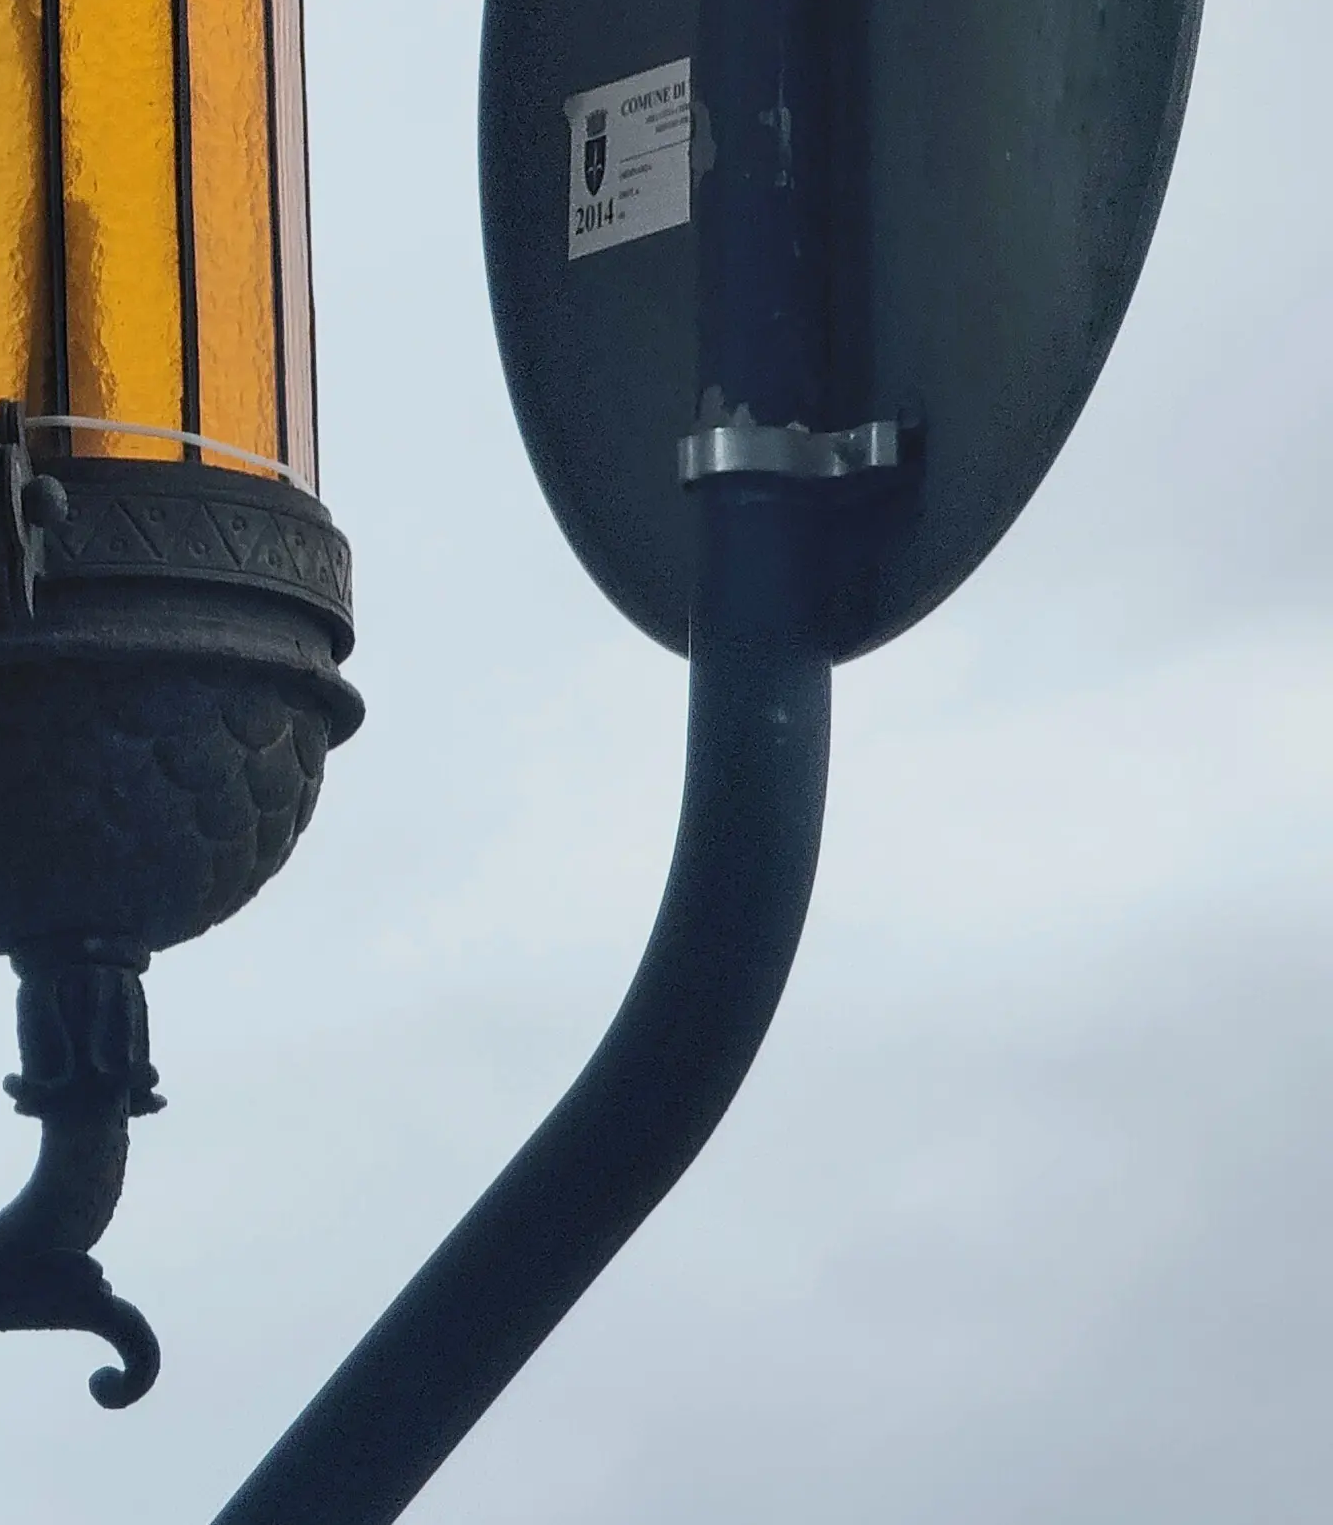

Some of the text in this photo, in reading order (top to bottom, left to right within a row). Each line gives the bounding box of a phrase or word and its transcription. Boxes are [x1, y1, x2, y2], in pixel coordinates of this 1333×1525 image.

[620, 85, 671, 117] COMUNE
[673, 81, 686, 102] DI
[575, 197, 614, 235] 2014
